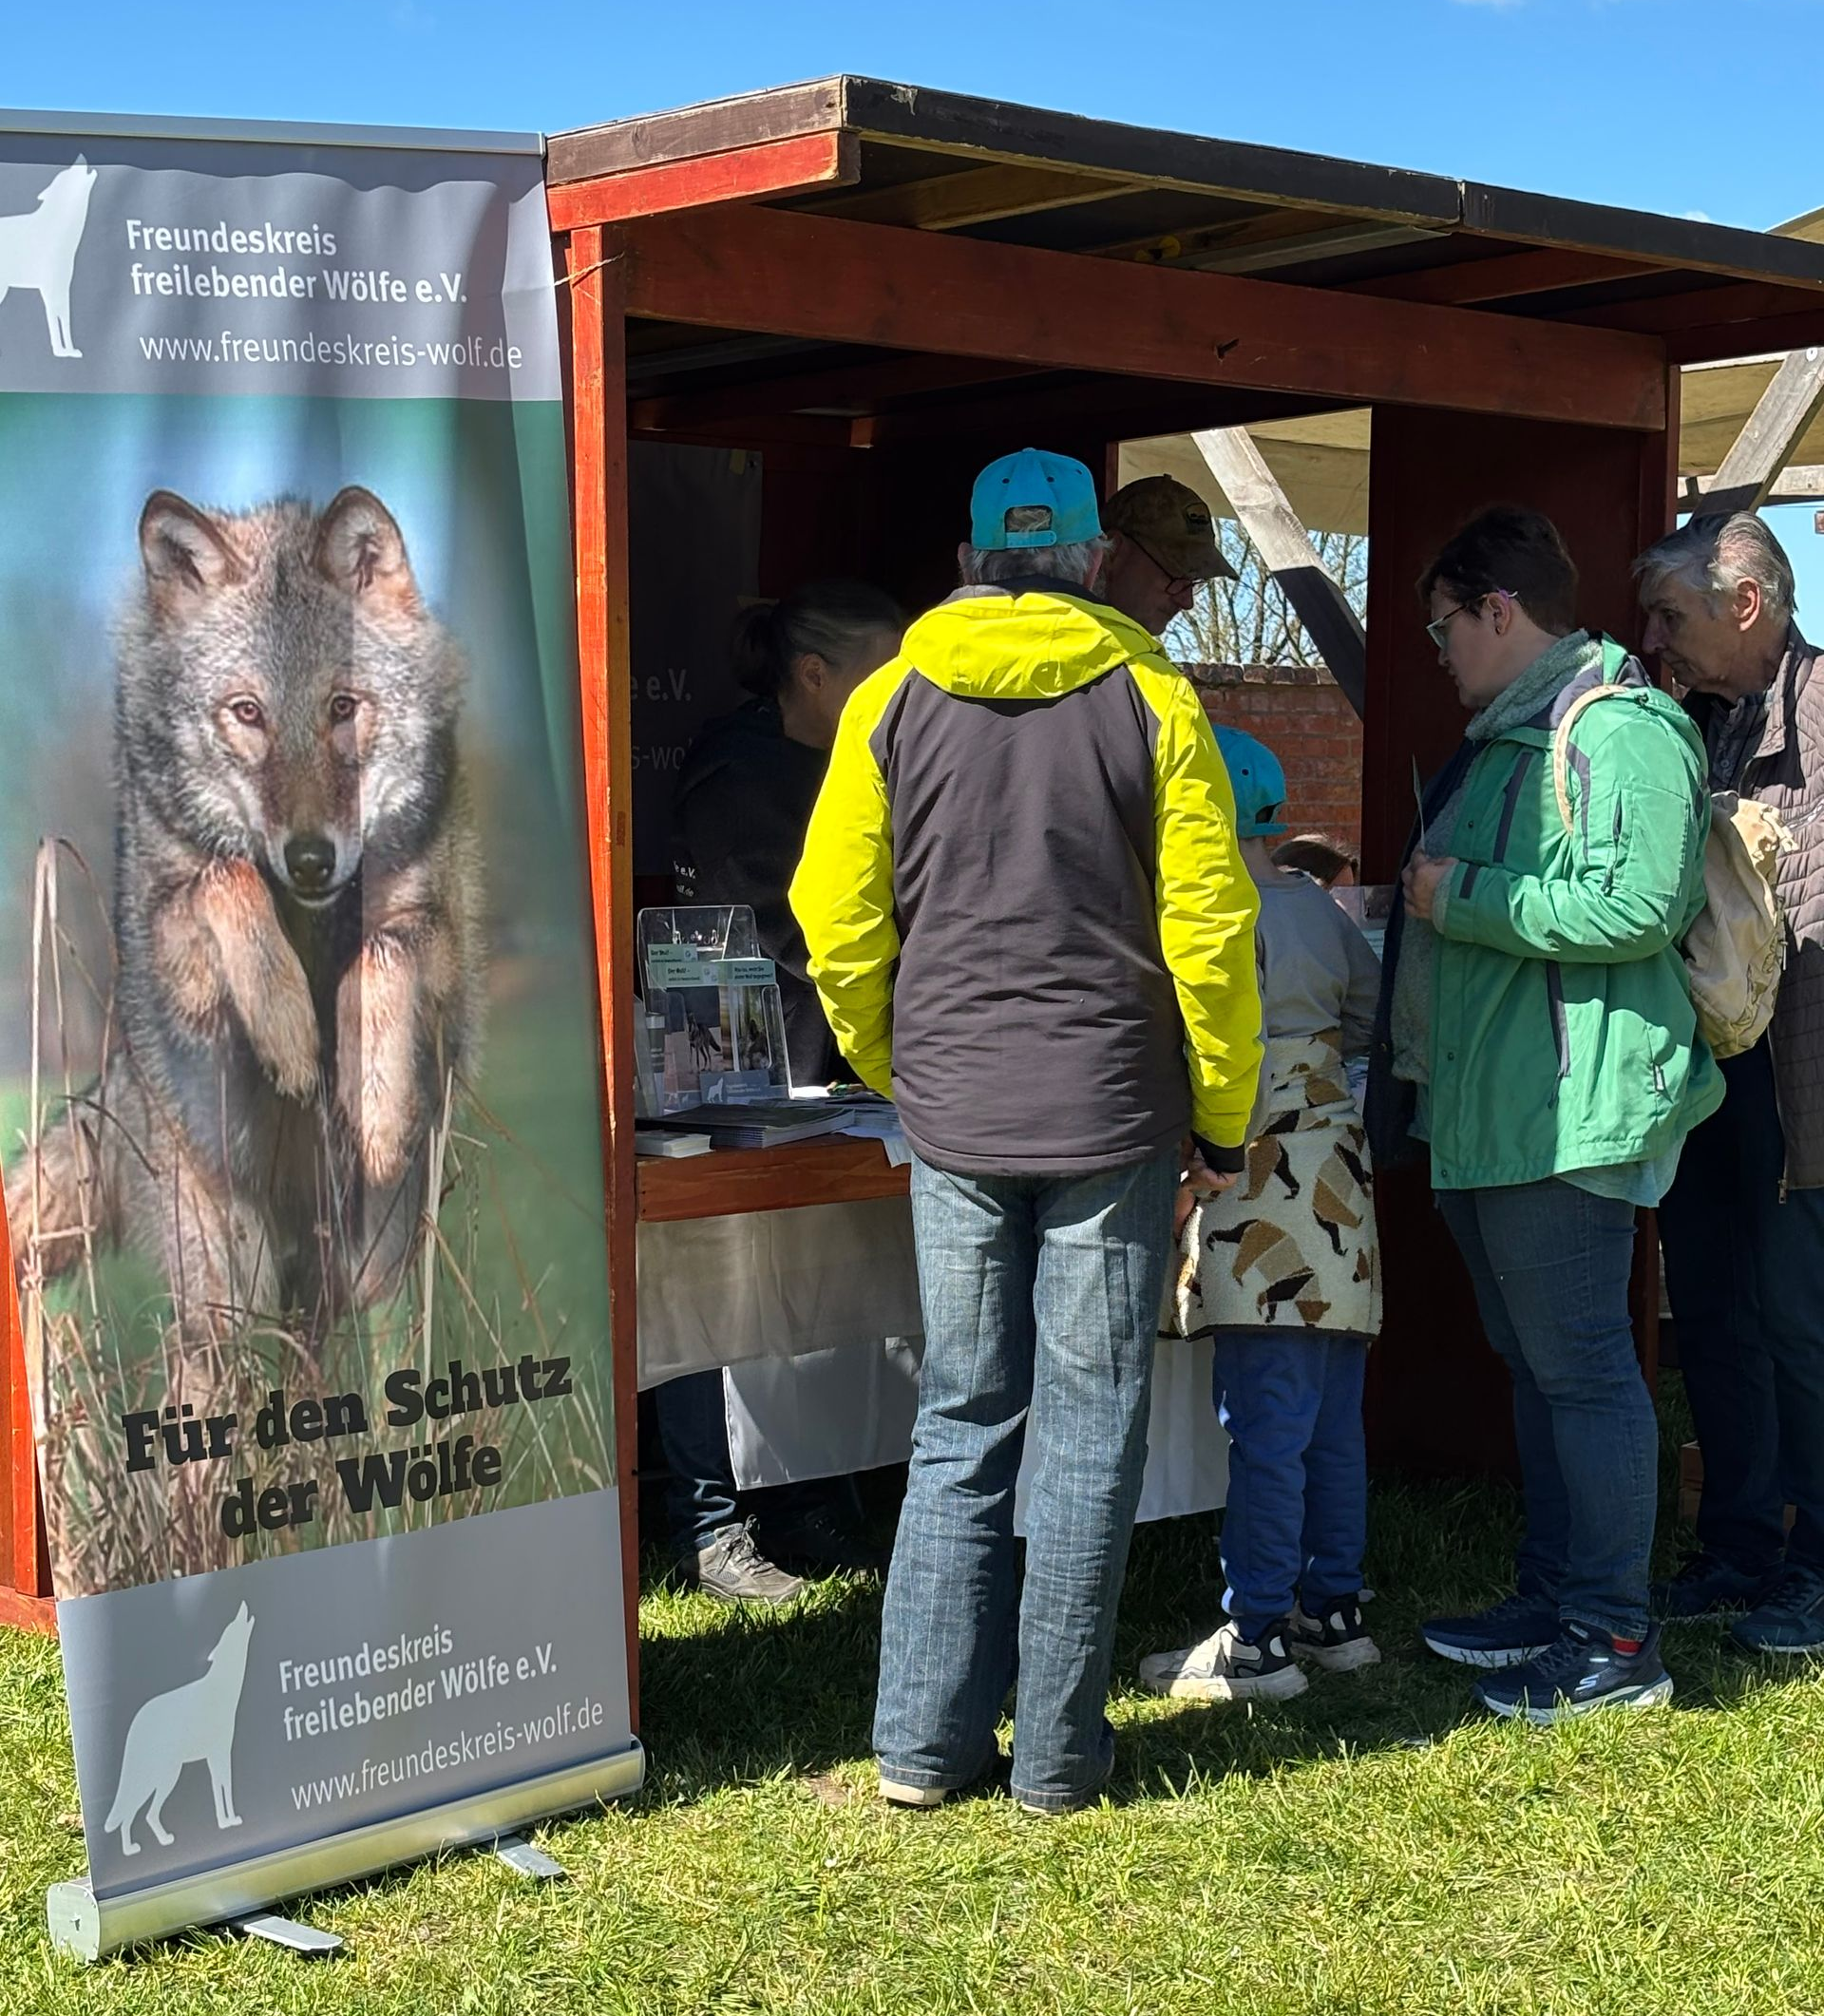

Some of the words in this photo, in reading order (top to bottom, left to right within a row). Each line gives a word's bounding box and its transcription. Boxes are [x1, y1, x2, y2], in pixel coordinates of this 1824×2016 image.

[125, 219, 337, 257] Freundeskreis
[131, 264, 316, 299] freilebender
[323, 269, 408, 304] Wölfe
[415, 273, 467, 303] e.V.
[140, 331, 522, 370] www.freundeskreis-wolf.de
[646, 668, 693, 702] e.V.
[122, 1403, 238, 1473] Für
[256, 1389, 369, 1450] den
[384, 1355, 573, 1427] Schutz
[221, 1477, 318, 1539] der
[336, 1436, 503, 1514] Wölfe
[279, 1624, 453, 1694] Freundeskreis
[283, 1678, 436, 1741] freilebender
[440, 1655, 510, 1701] Wölfe
[516, 1643, 558, 1681] e.V.
[291, 1697, 603, 1810] www.freundeskreis-wolf.de
